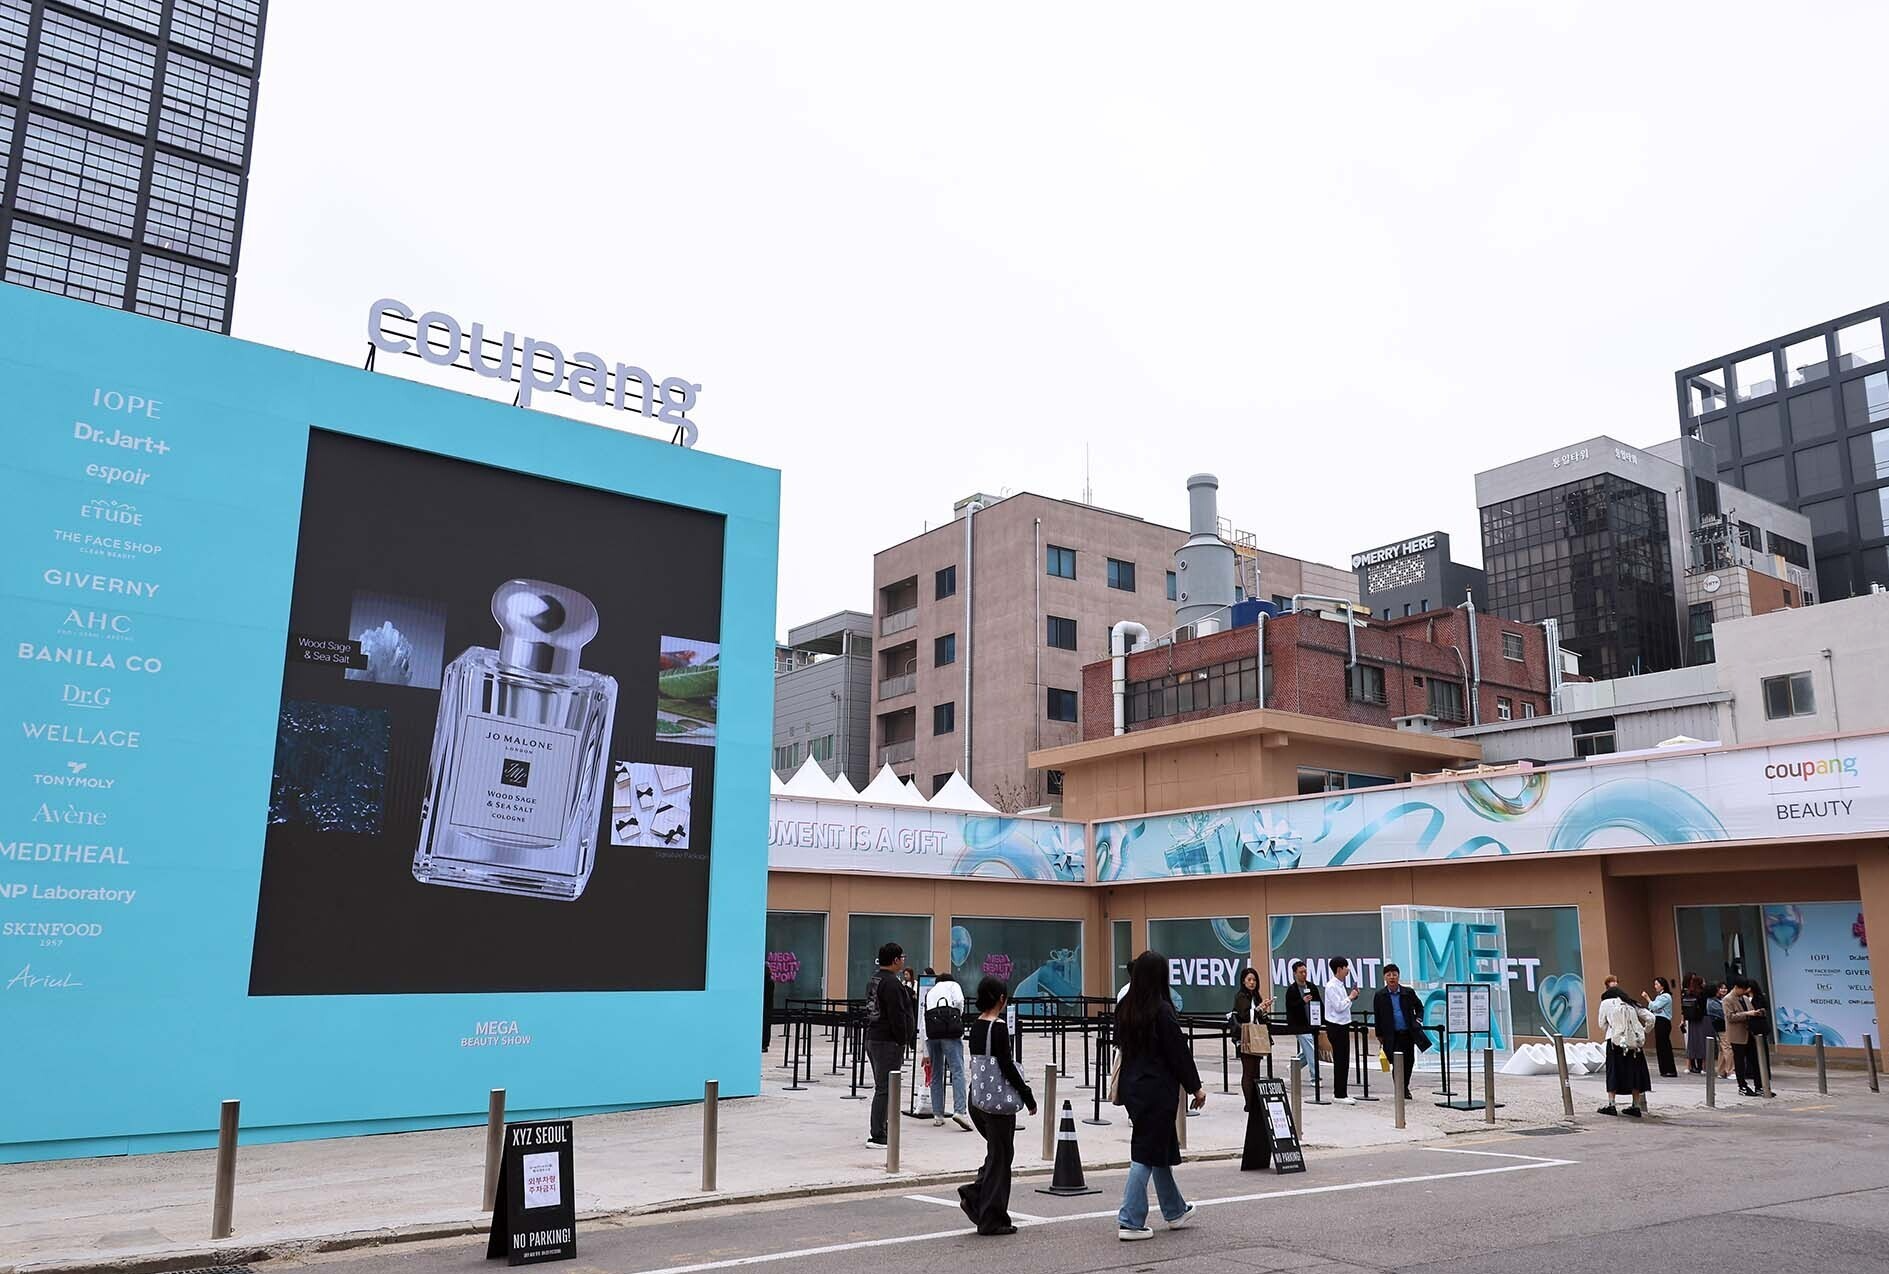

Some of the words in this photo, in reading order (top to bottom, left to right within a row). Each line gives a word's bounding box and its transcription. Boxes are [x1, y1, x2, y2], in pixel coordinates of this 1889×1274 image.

[367, 297, 702, 449] coupang
[92, 388, 164, 420] IOPE
[73, 421, 171, 455] Dr.Jart+
[85, 462, 151, 486] espoir
[80, 504, 144, 527] ETUDE
[53, 529, 81, 543] THE
[84, 535, 121, 550] FACE
[123, 540, 162, 555] SHOP
[1361, 544, 1400, 567] MERRY
[1402, 535, 1436, 556] HERE
[43, 568, 160, 599] GIVERNY
[63, 607, 133, 634] AHC
[298, 638, 326, 649] Wood
[327, 641, 351, 653] Sage
[18, 642, 116, 670] BANILA
[125, 655, 162, 673] CO
[304, 650, 311, 659] &
[312, 652, 331, 662] Sea
[333, 654, 350, 664] Salt
[61, 683, 112, 707] Dr.G
[22, 721, 141, 748] WELLAGE
[485, 732, 501, 740] JO
[503, 735, 553, 750] MALONE
[505, 746, 533, 754] LONDON
[1765, 756, 1858, 781] coupang
[33, 773, 115, 789] TONYMOLY
[486, 800, 493, 808] &
[495, 801, 512, 811] SEA
[513, 804, 534, 814] SALT
[487, 789, 514, 801] WOOD
[515, 794, 537, 805] SAGE
[32, 800, 107, 826] Avène
[491, 813, 526, 822] COLOGNE
[1776, 799, 1853, 820] BEAUTY
[850, 824, 871, 851] IS
[875, 827, 894, 852] A
[898, 828, 947, 856] GIFT
[0, 841, 130, 865] MEDIHEAL
[31, 884, 136, 904] Laboratory
[2, 921, 103, 937] SKINFOOD
[1168, 957, 1240, 987] EVERY
[475, 1020, 519, 1036] MEGA
[460, 1036, 500, 1047] BEAUTY
[501, 1035, 532, 1045] SHOW
[986, 1093, 992, 1101] 9
[1007, 1094, 1013, 1103] 8
[512, 1128, 532, 1146] XYZ
[513, 1233, 526, 1249] NO
[529, 1228, 571, 1248] PARKING!
